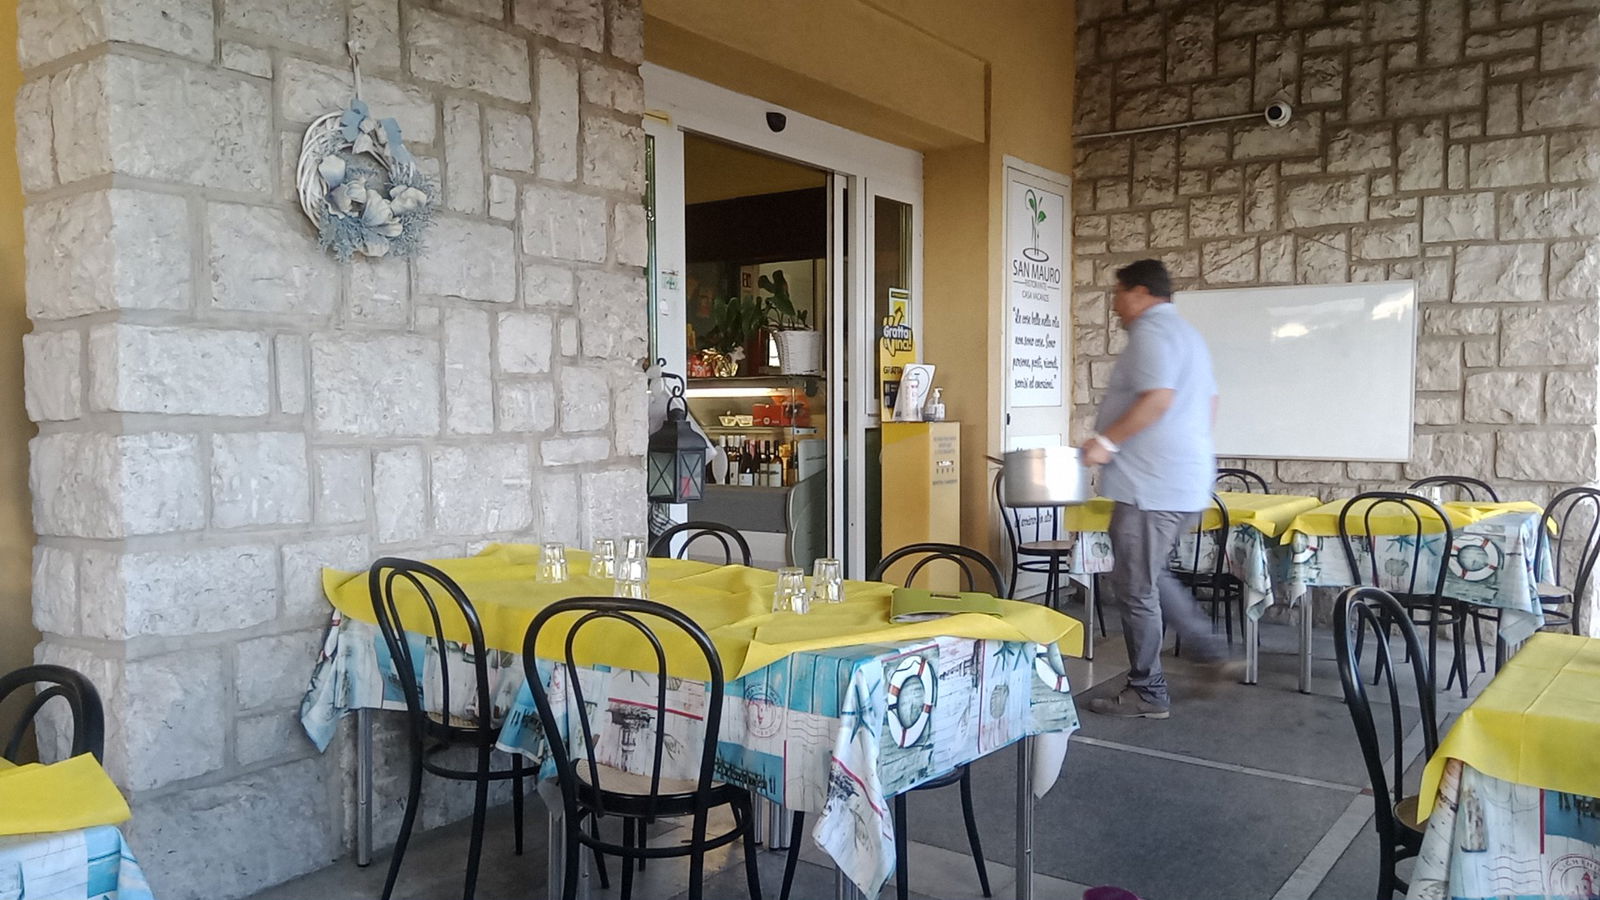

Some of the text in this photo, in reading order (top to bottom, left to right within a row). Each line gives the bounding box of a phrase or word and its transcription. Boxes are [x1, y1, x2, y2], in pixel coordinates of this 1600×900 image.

[1013, 259, 1061, 284] SAN MAURO
[883, 325, 909, 340] Gratta
